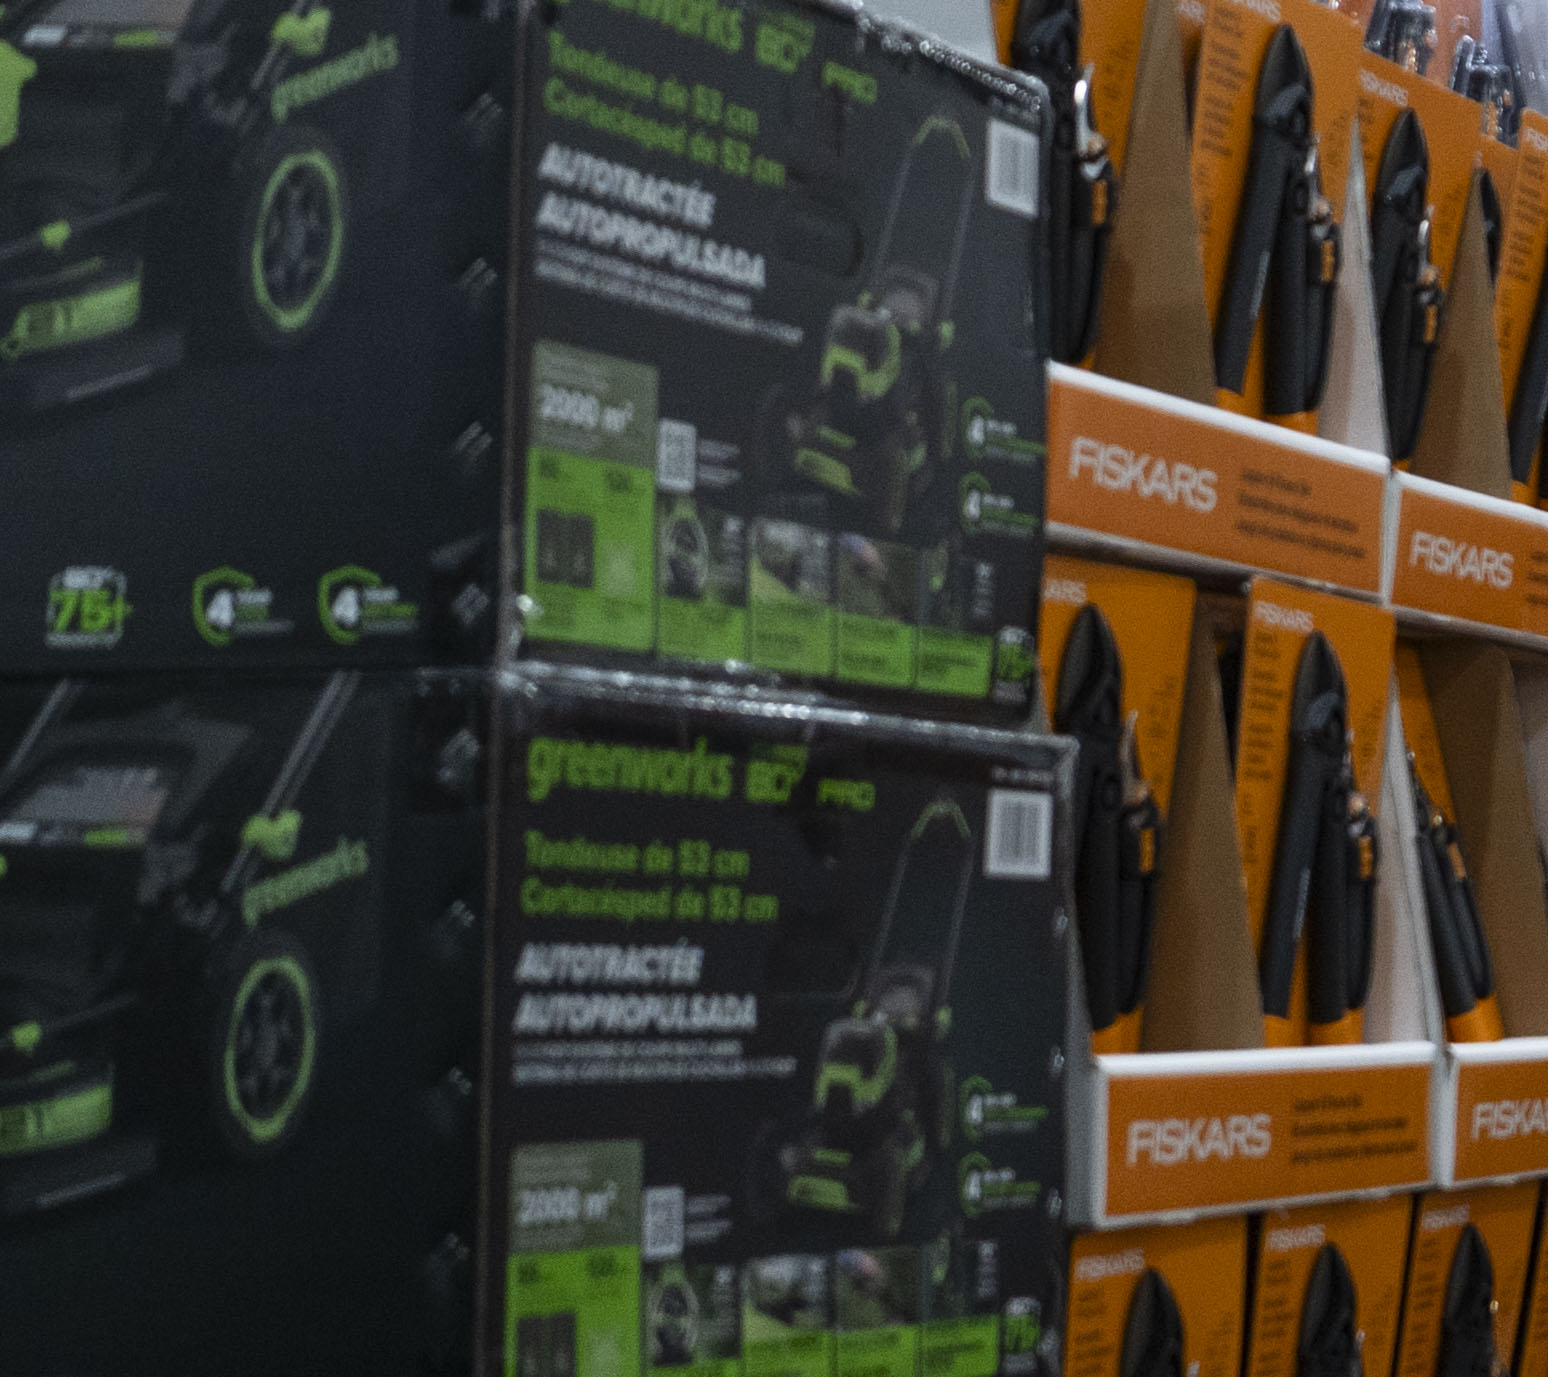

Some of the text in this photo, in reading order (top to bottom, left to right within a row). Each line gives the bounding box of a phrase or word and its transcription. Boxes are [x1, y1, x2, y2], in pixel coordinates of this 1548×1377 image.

[1360, 71, 1408, 106] FISKARS
[1068, 435, 1218, 513] FISKARS
[1410, 530, 1514, 589] FISKARS
[1254, 600, 1314, 633] FISKARS
[528, 736, 733, 803] greenworks
[1127, 1114, 1273, 1167] FISKARS
[1266, 1224, 1325, 1251] FISKARS
[1075, 1250, 1145, 1281] FISKARS
